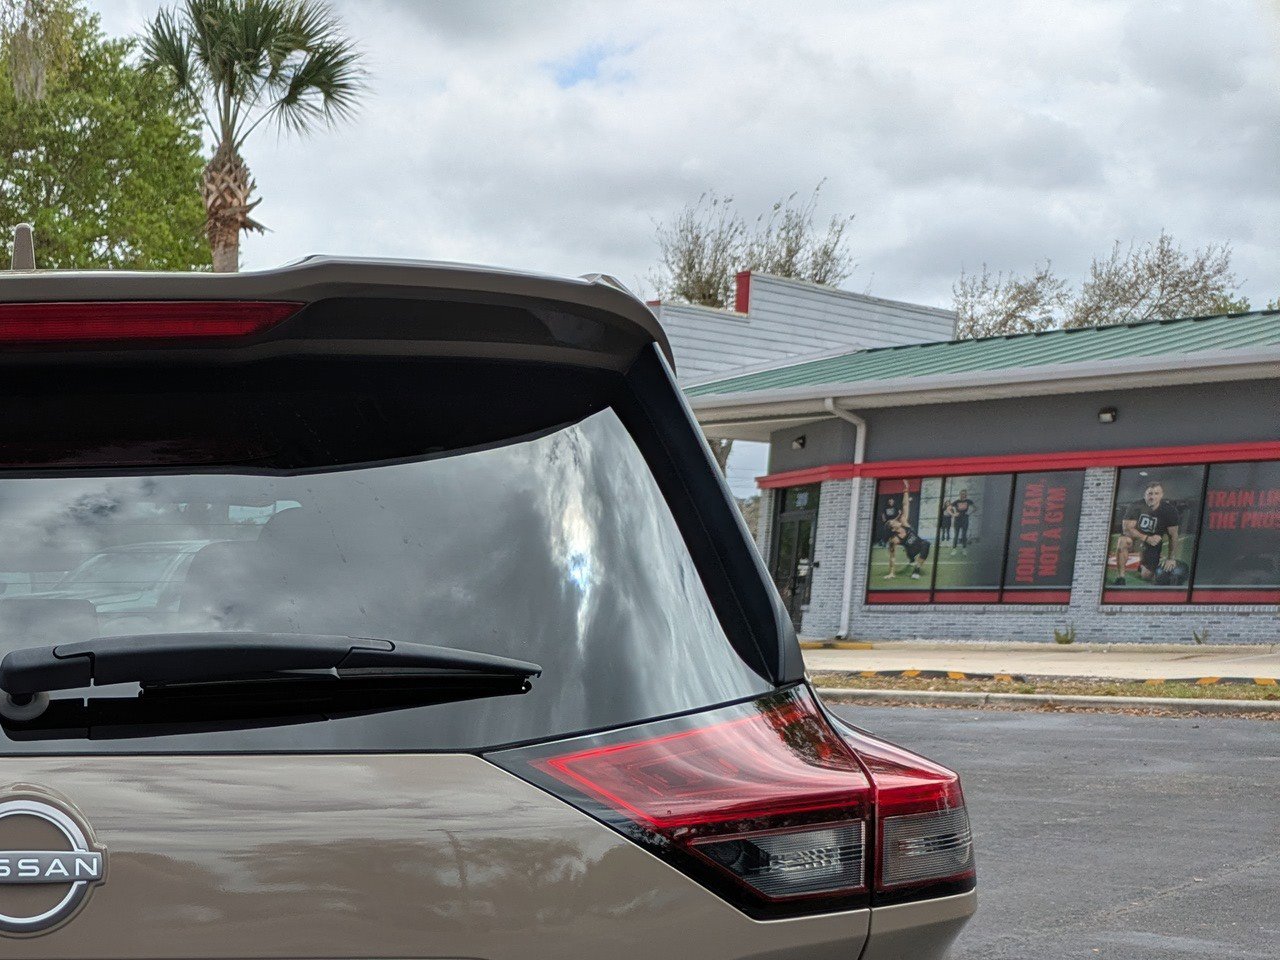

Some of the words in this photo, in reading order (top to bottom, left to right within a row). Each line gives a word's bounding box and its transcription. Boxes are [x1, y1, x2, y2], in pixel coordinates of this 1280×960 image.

[1044, 487, 1066, 523] GYM
[1020, 531, 1038, 542] A
[1042, 528, 1061, 539] A
[1038, 545, 1059, 576] NOT
